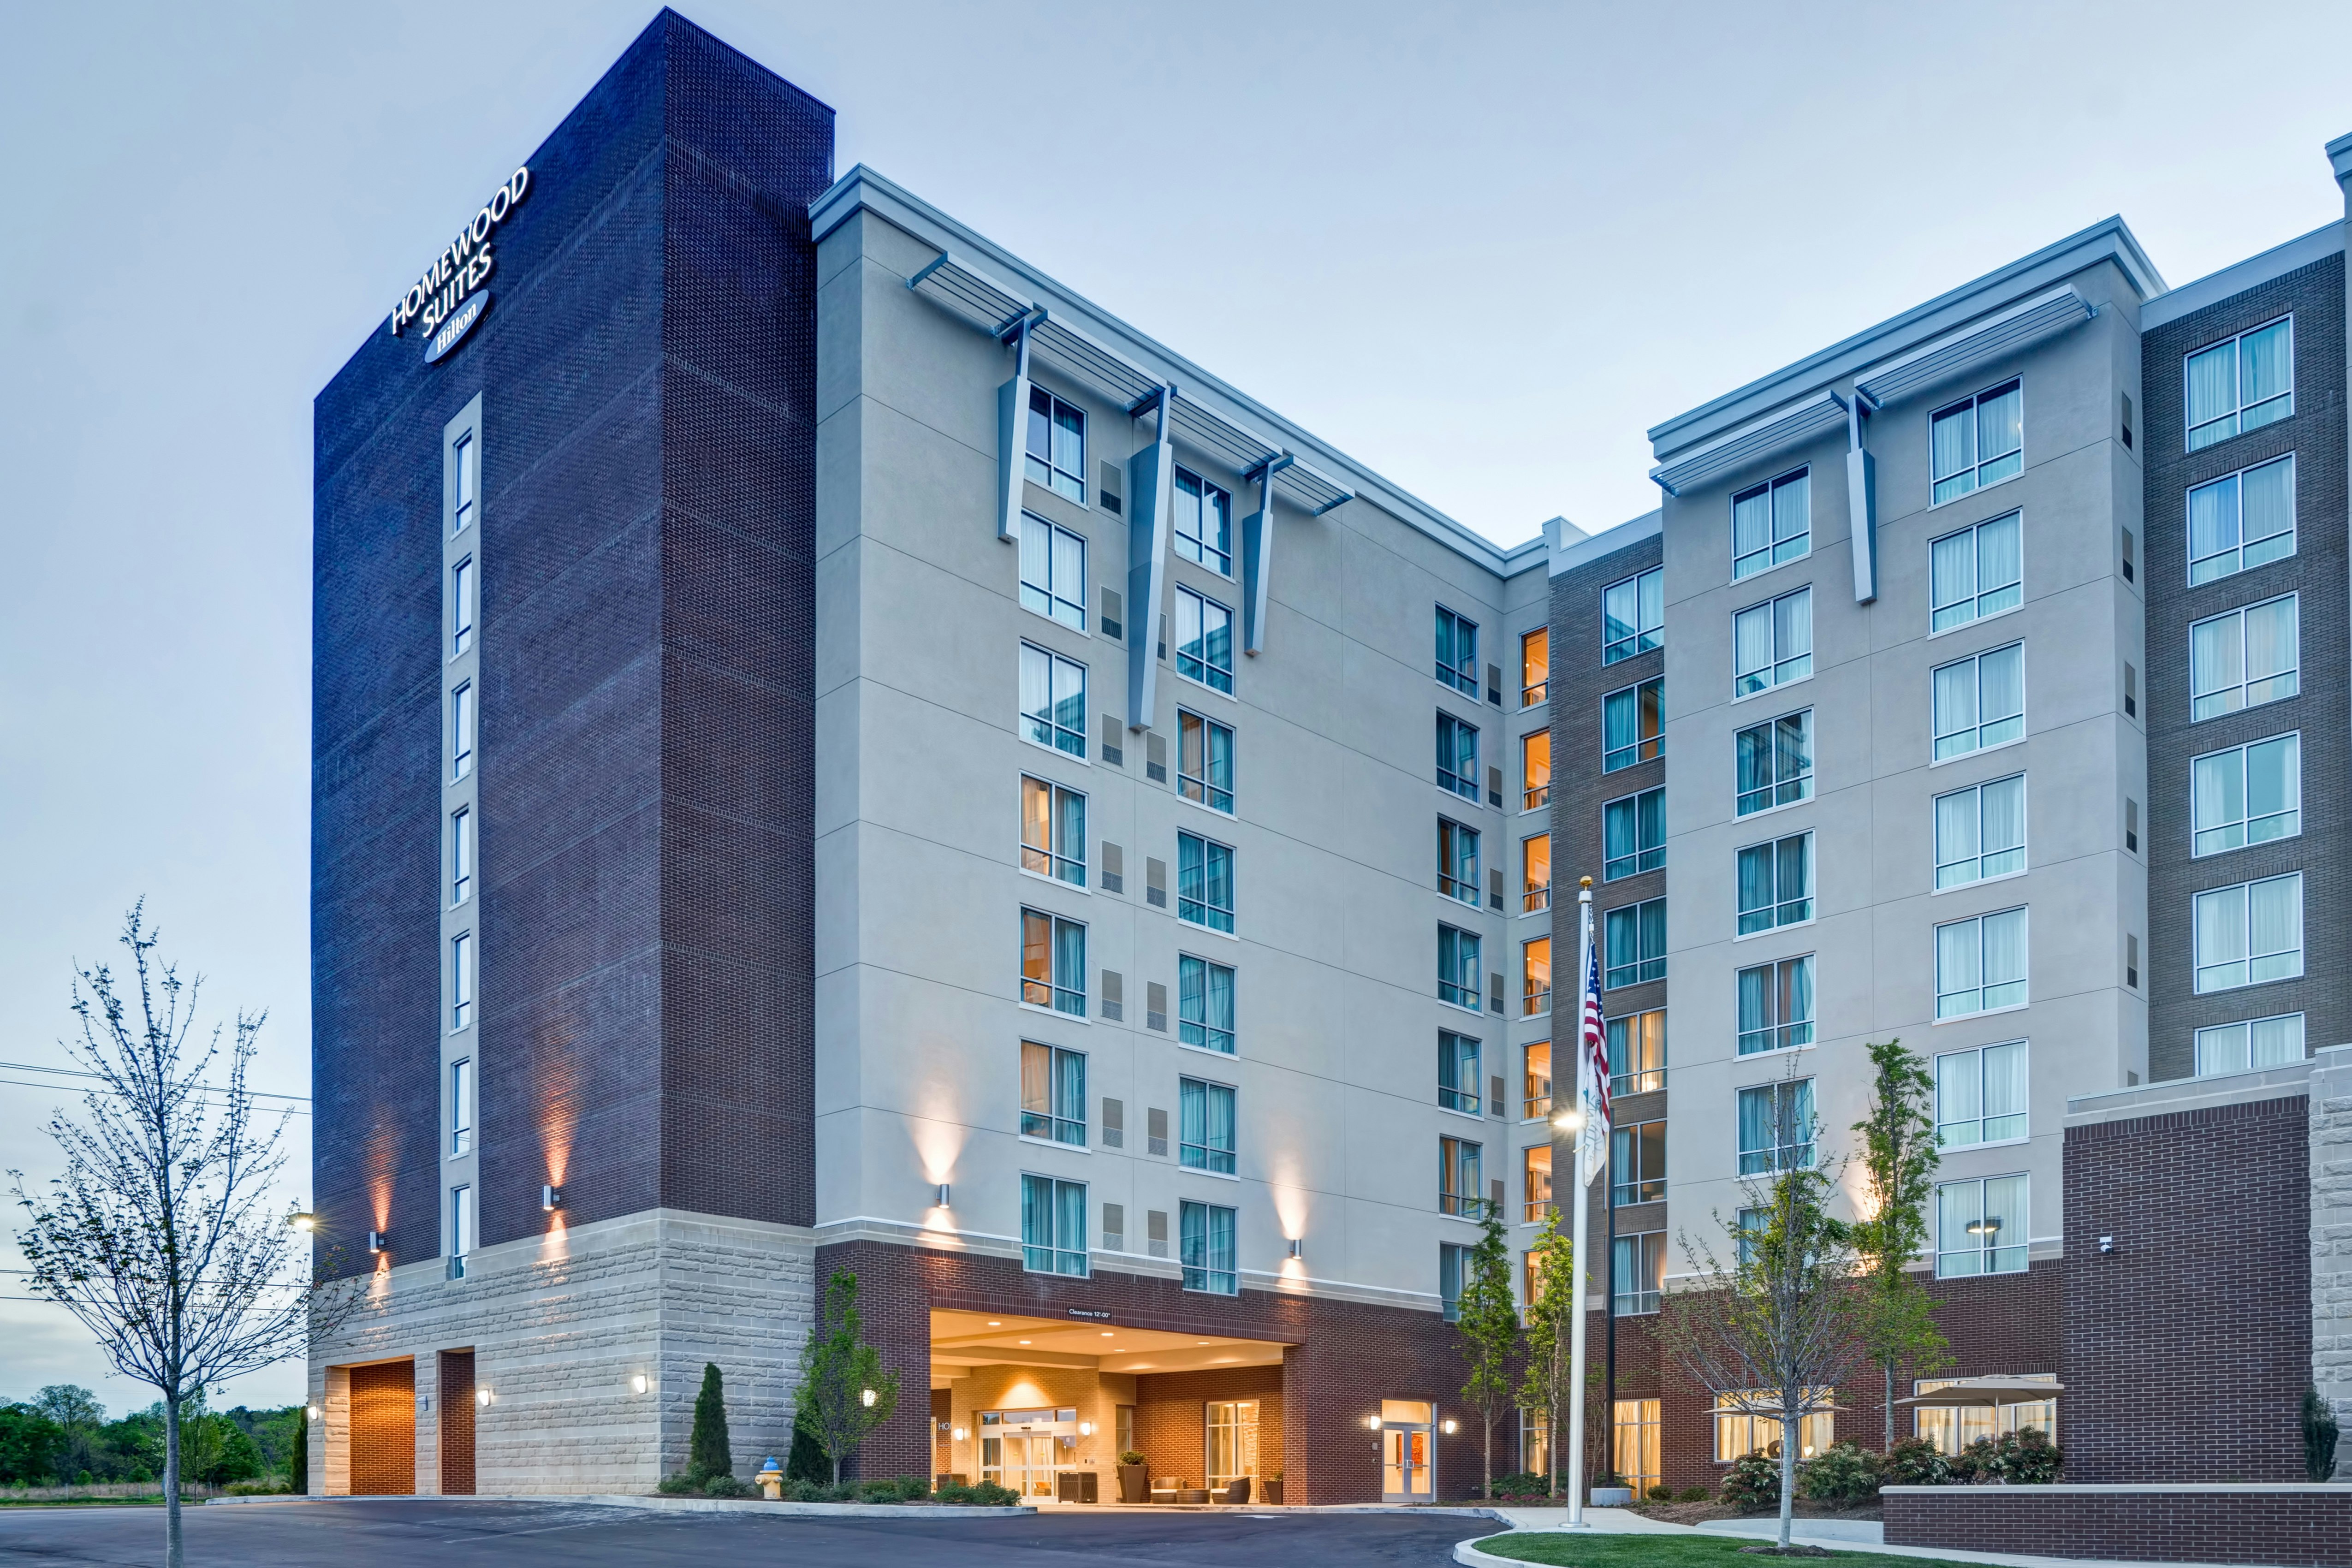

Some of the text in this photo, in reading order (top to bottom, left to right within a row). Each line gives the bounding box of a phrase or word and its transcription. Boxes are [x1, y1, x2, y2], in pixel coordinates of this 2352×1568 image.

[392, 166, 529, 335] HOMEWOOD
[423, 242, 493, 338] SUITES
[436, 303, 477, 354] Hilton
